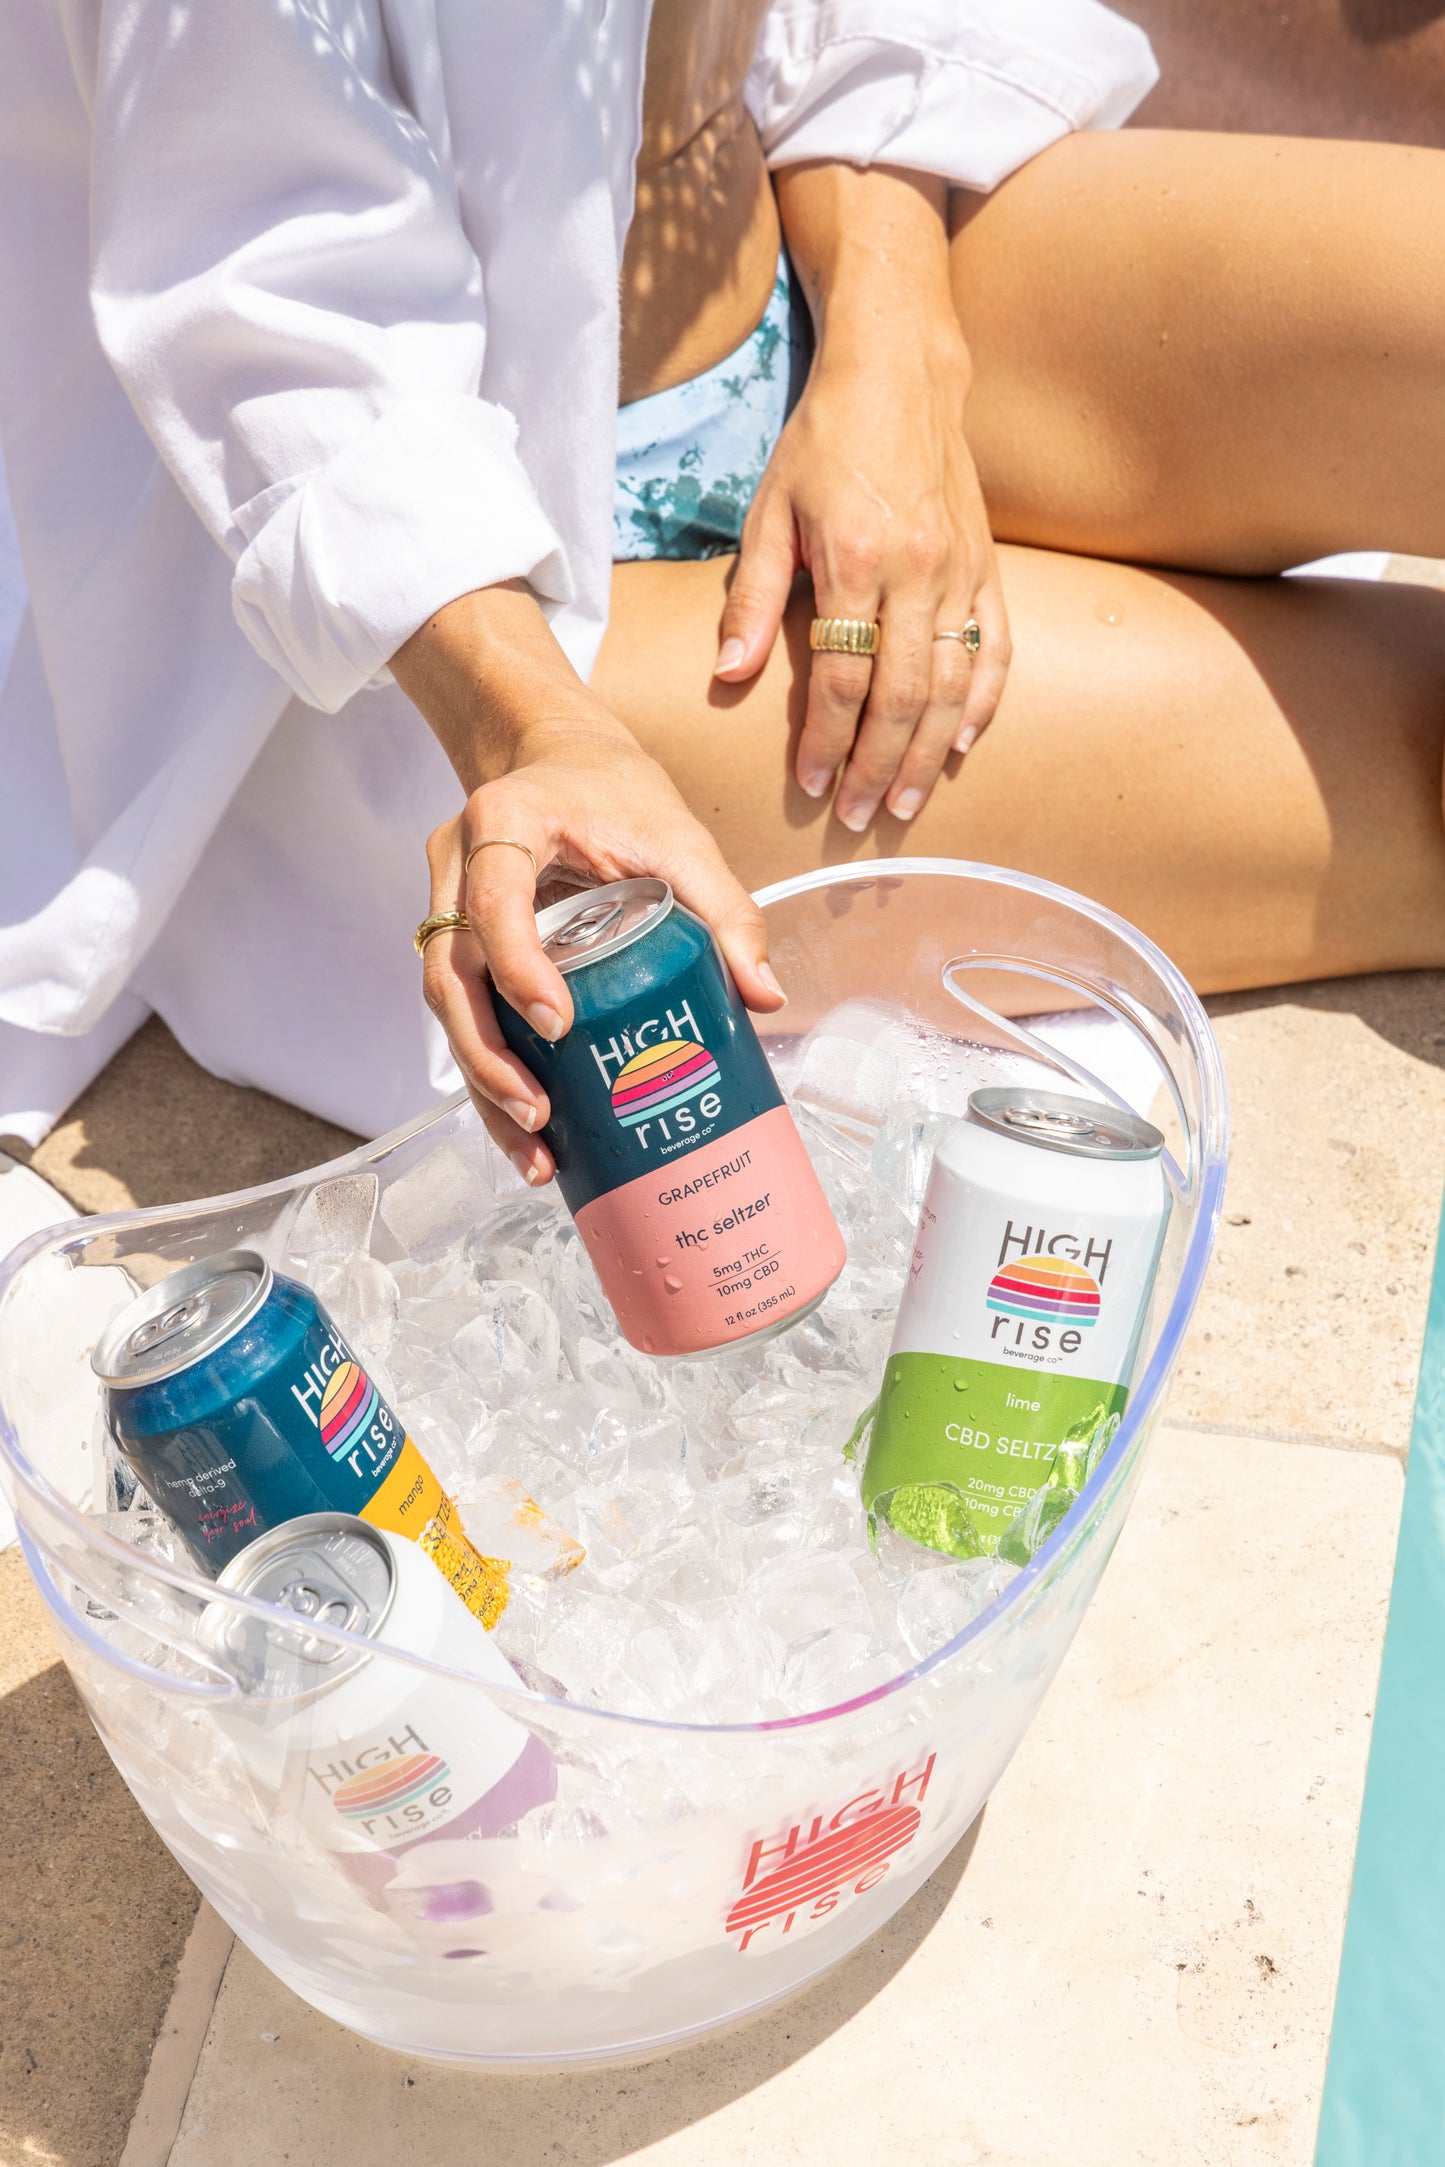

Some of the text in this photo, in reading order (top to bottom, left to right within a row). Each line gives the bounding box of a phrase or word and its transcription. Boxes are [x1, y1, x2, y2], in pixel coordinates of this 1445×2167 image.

[590, 1000, 704, 1090] HIGH
[635, 1093, 722, 1149] rise
[660, 1133, 701, 1154] beverage
[658, 1150, 752, 1205] GRAPEFRUIT
[675, 1193, 770, 1249] thc seltzer
[713, 1243, 770, 1278] 5mg THC
[997, 1220, 1112, 1286] HIGH
[716, 1260, 780, 1297] 10mg CBD
[724, 1285, 796, 1326] 12 fl oz (355 mL)
[991, 1315, 1082, 1354] rise
[1003, 1346, 1045, 1363] beverage
[291, 1325, 356, 1428] HIGH
[1006, 1392, 1041, 1412] lime
[347, 1406, 393, 1478] rise
[945, 1423, 1059, 1461] CBD SELTZ
[165, 1458, 237, 1489] hemp derived
[371, 1447, 394, 1478] beverage
[189, 1479, 226, 1498] delta-9
[398, 1474, 424, 1515] mango
[965, 1497, 1023, 1518] 10mg CB
[968, 1477, 1005, 1498] 20mg
[306, 1724, 430, 1796] HIGH
[362, 1787, 453, 1835] rise
[388, 1821, 431, 1840] beverage
[743, 1752, 937, 1890] HIGH
[738, 1862, 890, 1952] rise
